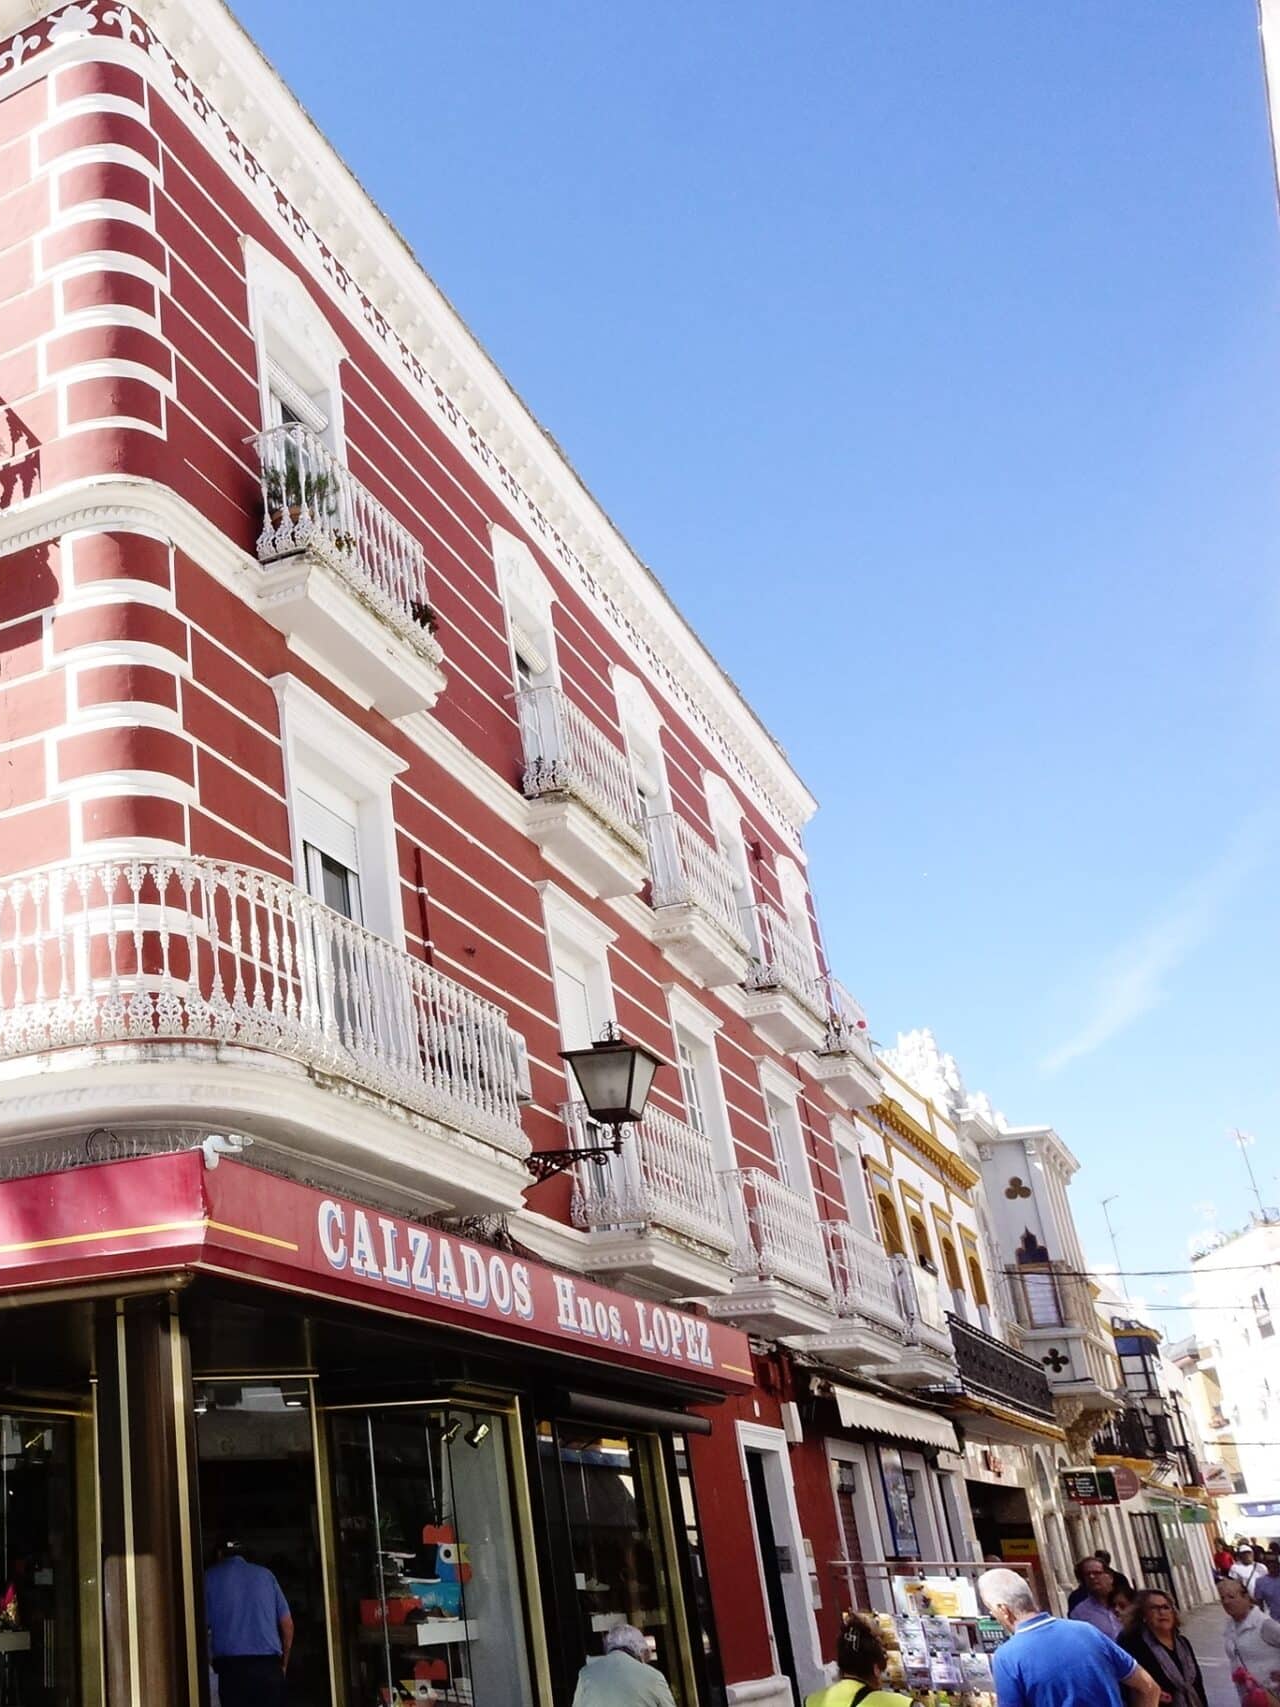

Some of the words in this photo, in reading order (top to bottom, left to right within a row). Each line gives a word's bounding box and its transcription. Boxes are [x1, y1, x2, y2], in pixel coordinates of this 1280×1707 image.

[317, 1199, 535, 1321] CALZADOS
[553, 1274, 631, 1346] Hnos.
[635, 1298, 715, 1369] LOPEZ
